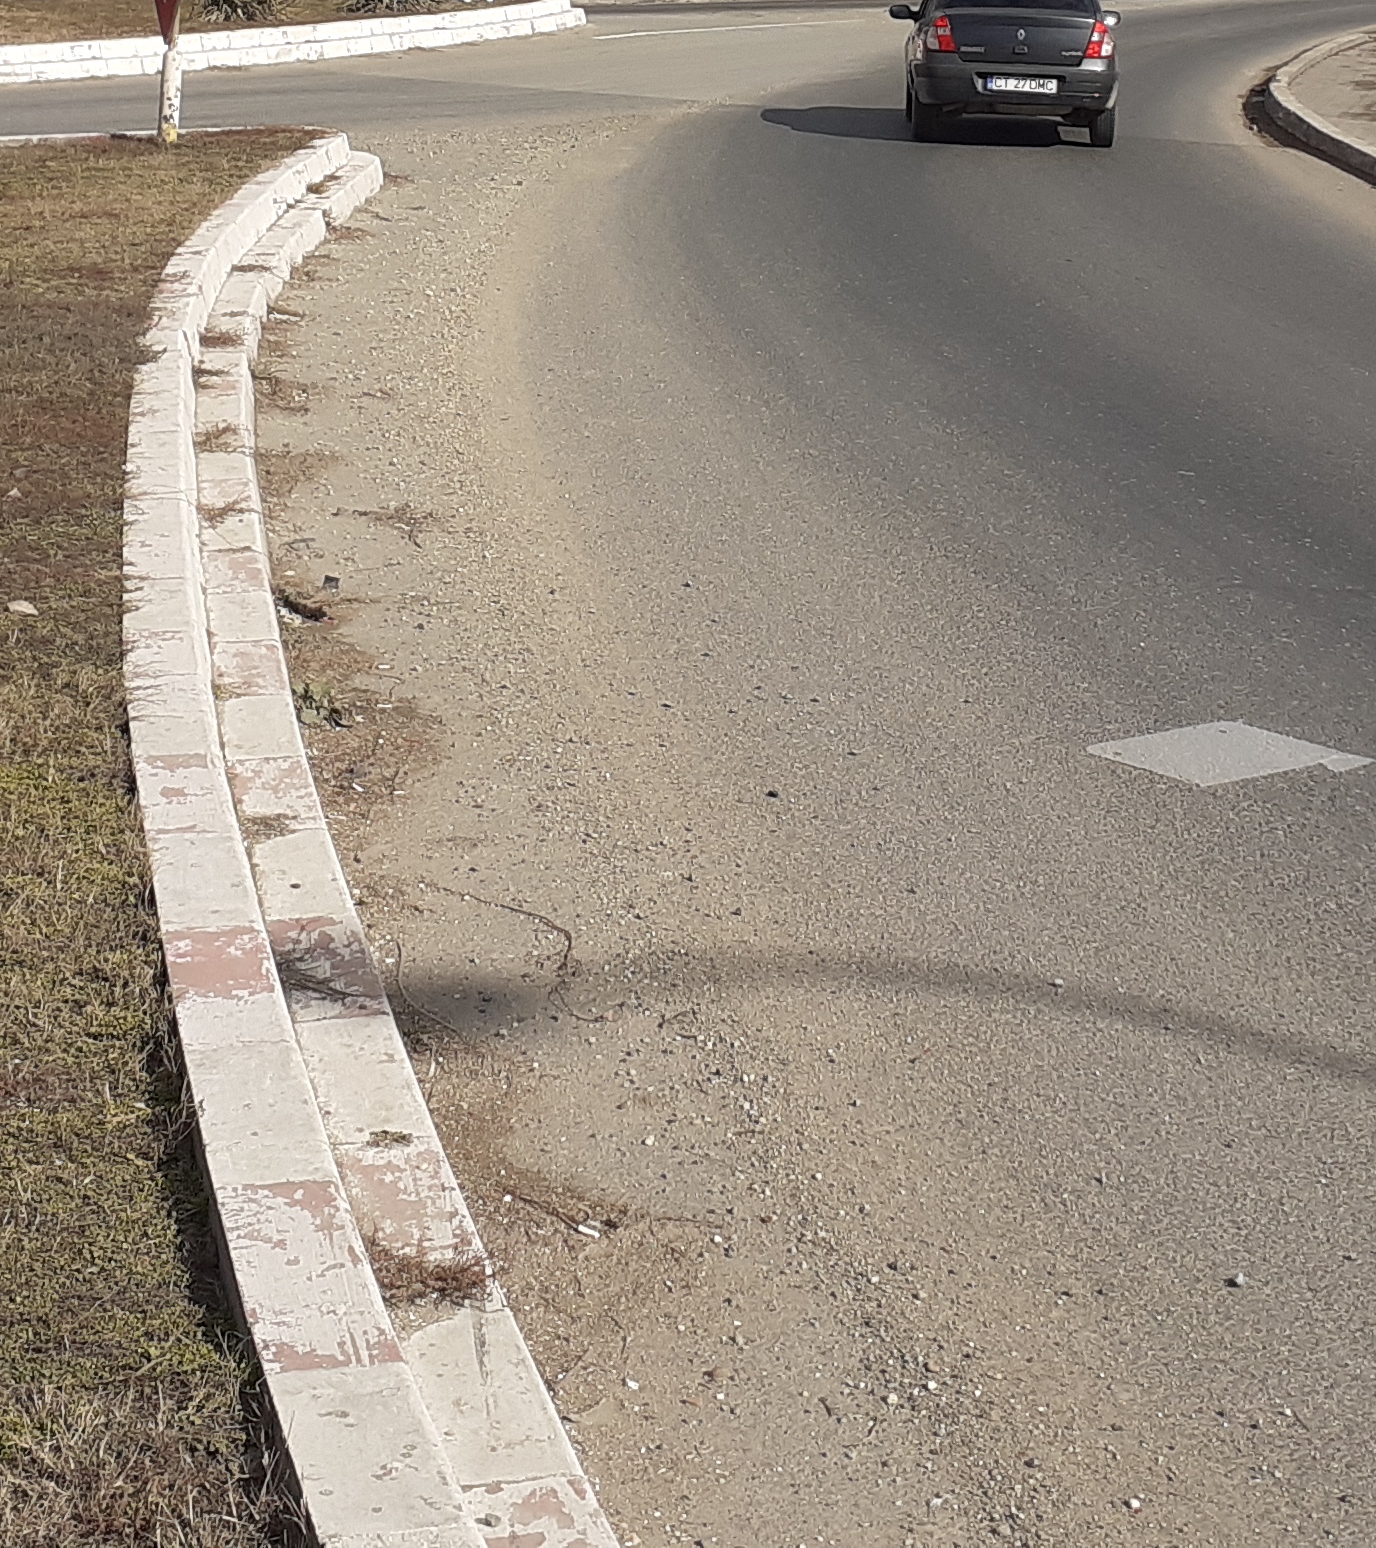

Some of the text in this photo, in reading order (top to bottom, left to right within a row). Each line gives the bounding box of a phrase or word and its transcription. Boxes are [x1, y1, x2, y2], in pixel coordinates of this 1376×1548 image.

[994, 77, 1054, 91] CT 27 DMC
